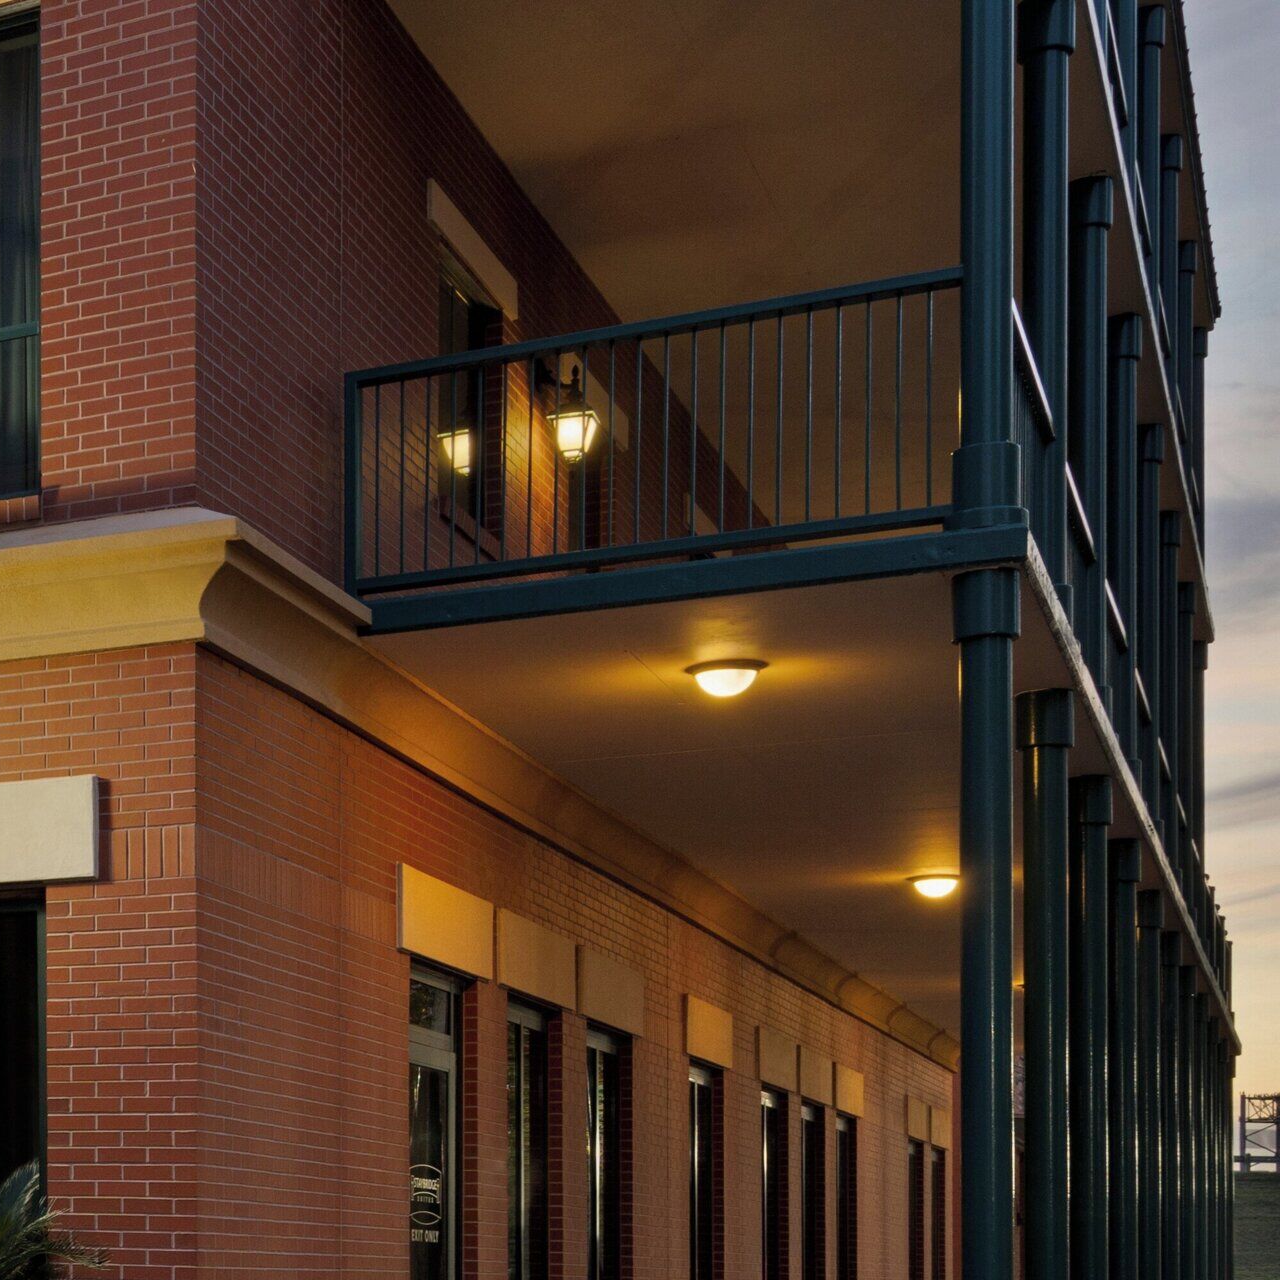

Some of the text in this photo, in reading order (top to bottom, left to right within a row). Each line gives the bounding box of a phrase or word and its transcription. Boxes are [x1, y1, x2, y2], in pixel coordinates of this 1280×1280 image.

[414, 1177, 438, 1190] STAYBRIDGE
[411, 1229, 439, 1243] EXIT ONLY
